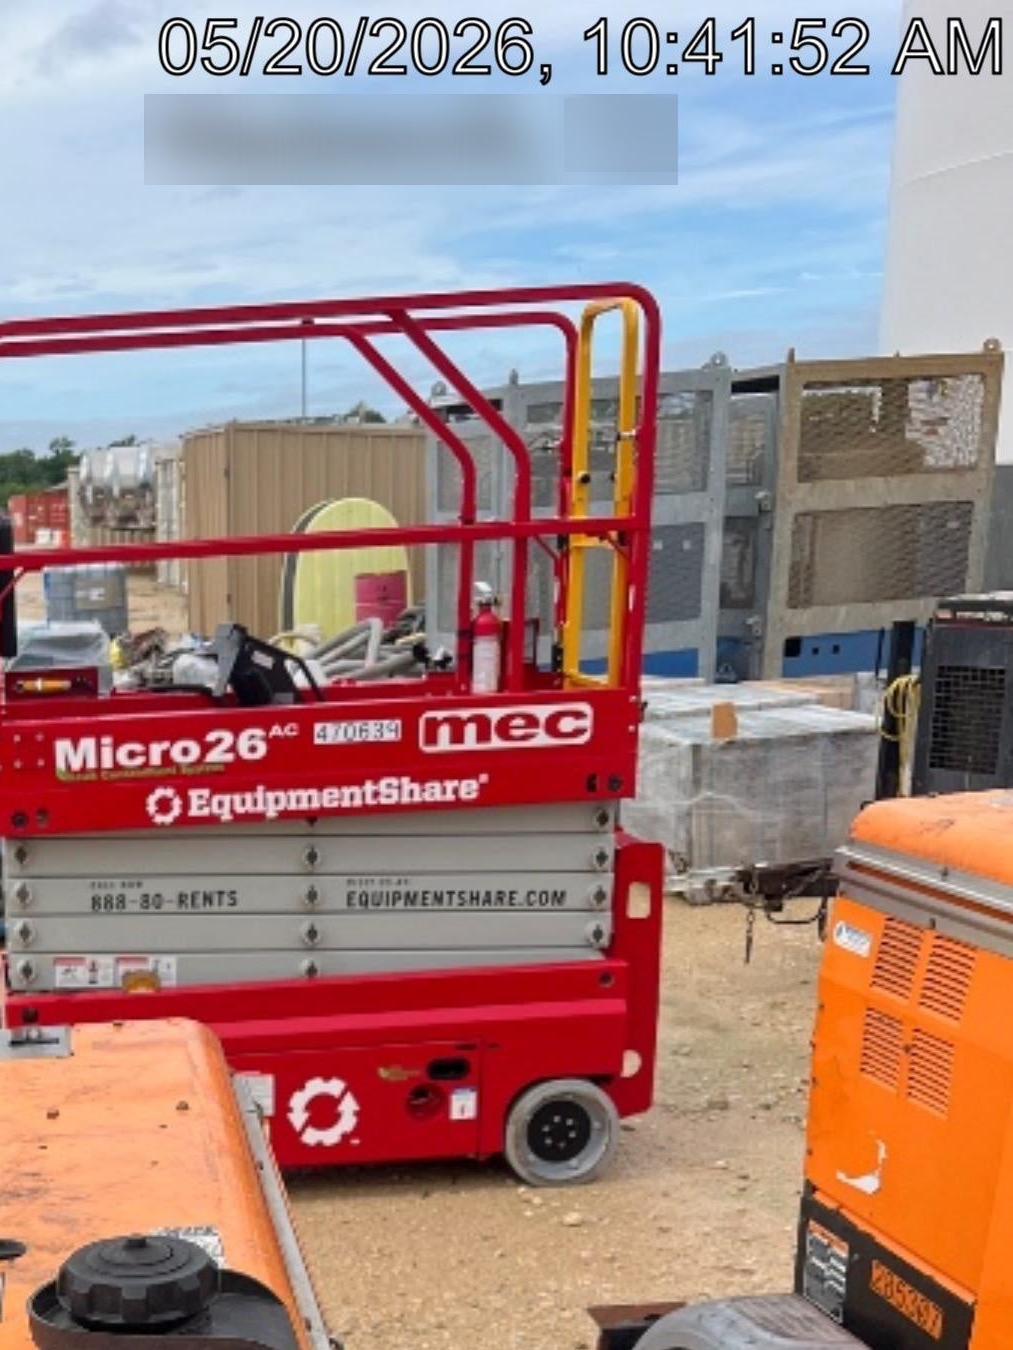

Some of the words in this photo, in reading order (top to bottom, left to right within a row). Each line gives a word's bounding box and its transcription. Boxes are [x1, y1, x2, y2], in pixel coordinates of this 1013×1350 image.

[422, 708, 589, 747] mec
[54, 727, 268, 772] Micro26
[269, 723, 300, 738] AC
[188, 774, 480, 822] EquipmentShare
[91, 890, 237, 911] 888-80-RENTS
[346, 889, 567, 909] EQUIPMENTSHARE.COM
